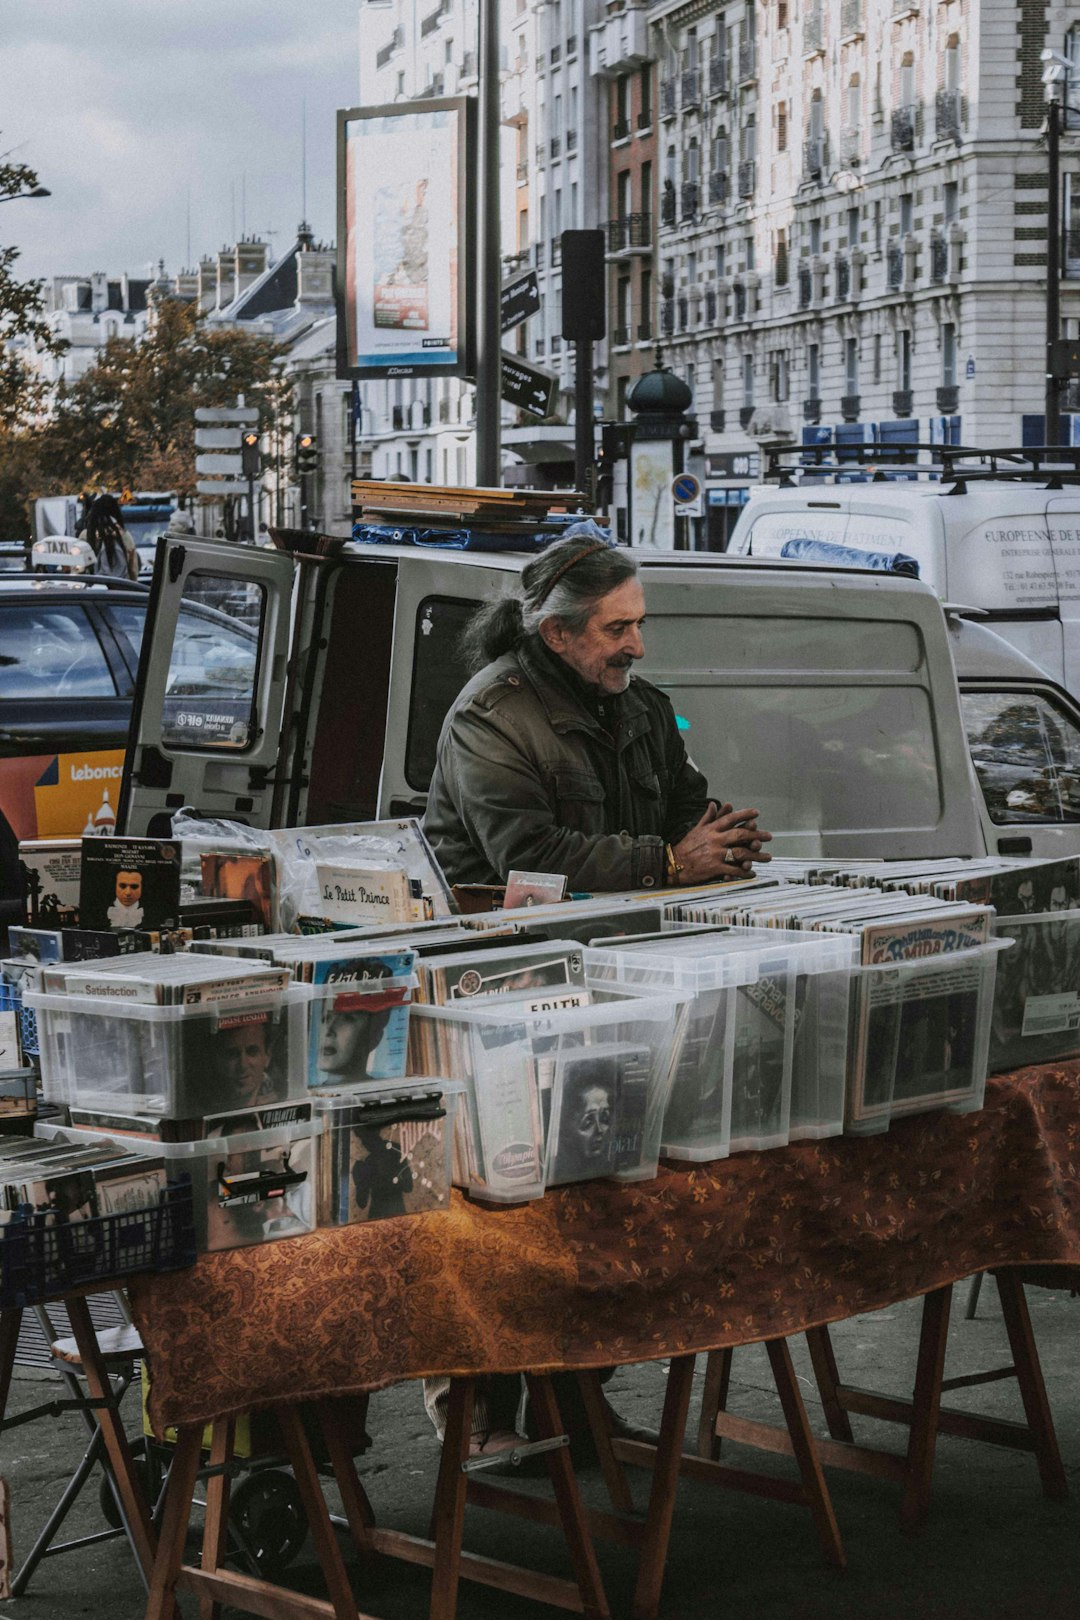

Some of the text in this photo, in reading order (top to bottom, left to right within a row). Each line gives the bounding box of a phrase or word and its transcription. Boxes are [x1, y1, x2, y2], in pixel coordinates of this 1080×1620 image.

[323, 884, 391, 905] Le Petit Prince
[85, 984, 138, 997] Satisfaction
